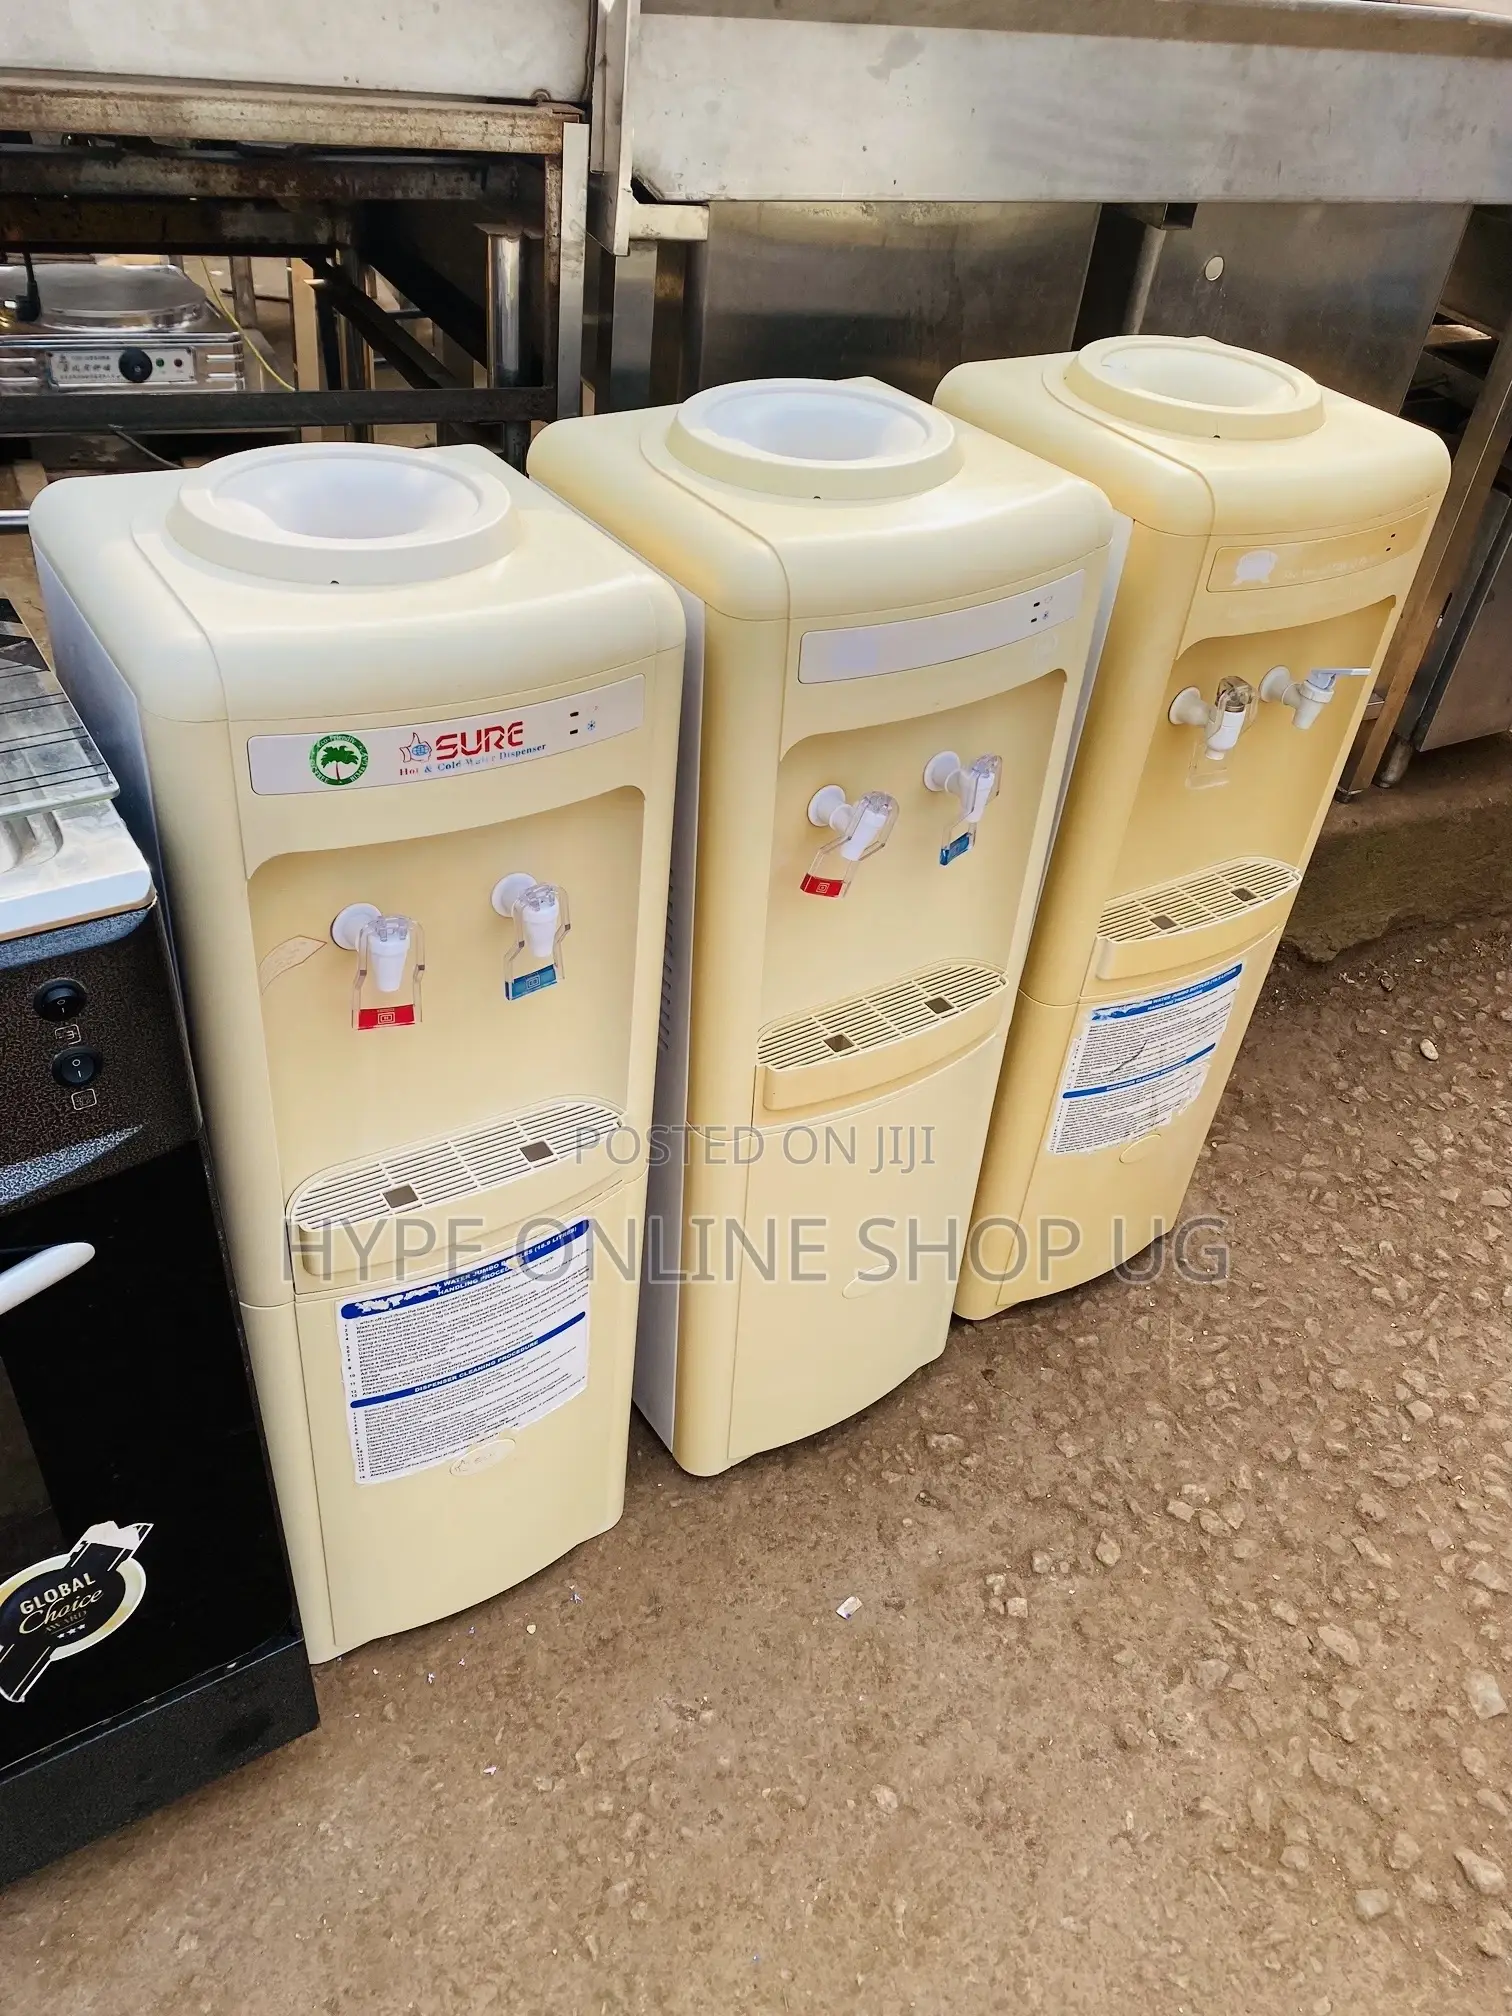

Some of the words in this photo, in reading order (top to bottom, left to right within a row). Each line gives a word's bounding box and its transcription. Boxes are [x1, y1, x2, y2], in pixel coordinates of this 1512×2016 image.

[423, 765, 432, 774] &
[437, 760, 462, 771] Cold
[499, 743, 547, 760] Dispenser
[435, 720, 524, 761] SURE
[437, 1279, 479, 1296] HANDLING
[443, 1272, 471, 1287] WATER
[472, 1263, 500, 1277] JUMBO
[414, 1374, 458, 1393] DISPENSER
[459, 1359, 496, 1379] CLEANING
[497, 1338, 539, 1363] PROCEDURE
[18, 1589, 104, 1634] Choice
[19, 1572, 97, 1615] GLOBAL
